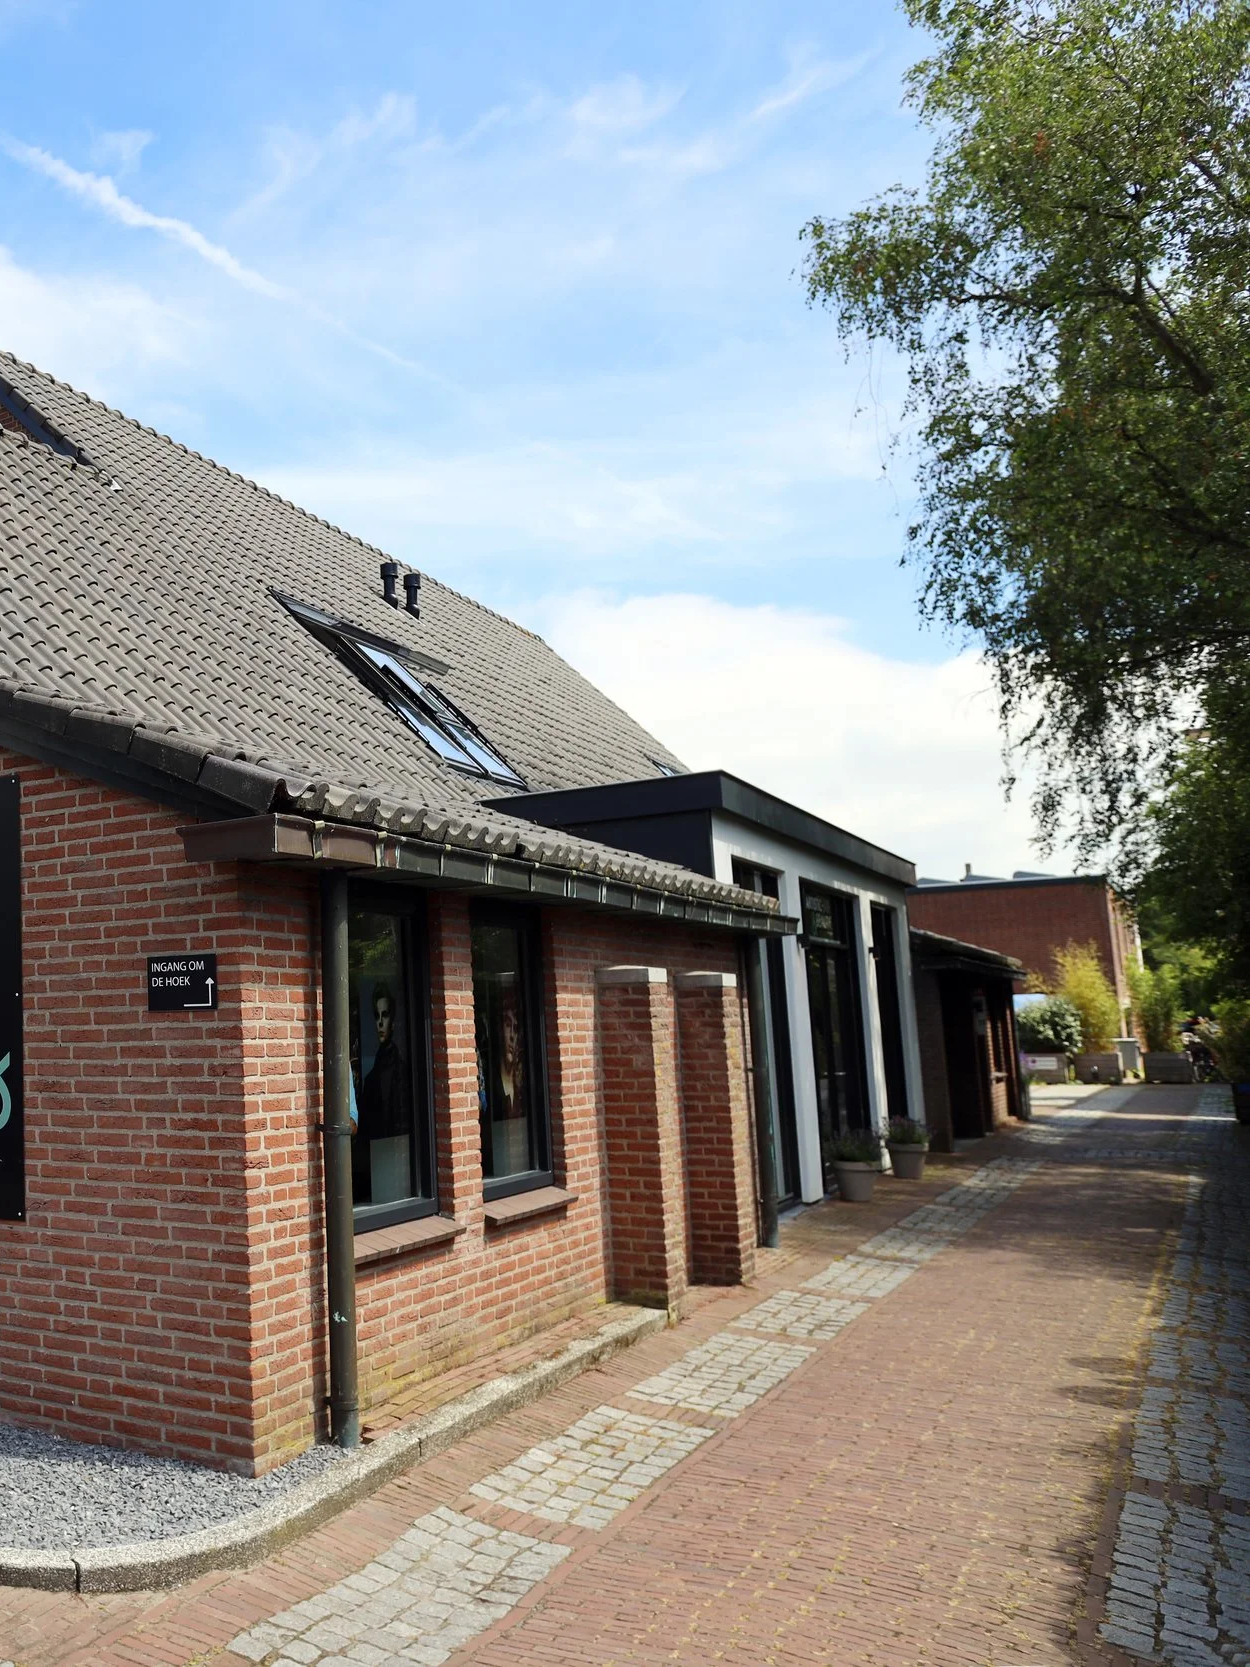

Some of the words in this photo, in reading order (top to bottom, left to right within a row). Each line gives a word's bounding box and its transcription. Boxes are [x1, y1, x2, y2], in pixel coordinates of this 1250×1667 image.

[151, 962, 187, 973] INGANG
[189, 961, 205, 971] OM
[151, 977, 164, 987] DE
[165, 976, 191, 987] HOEK
